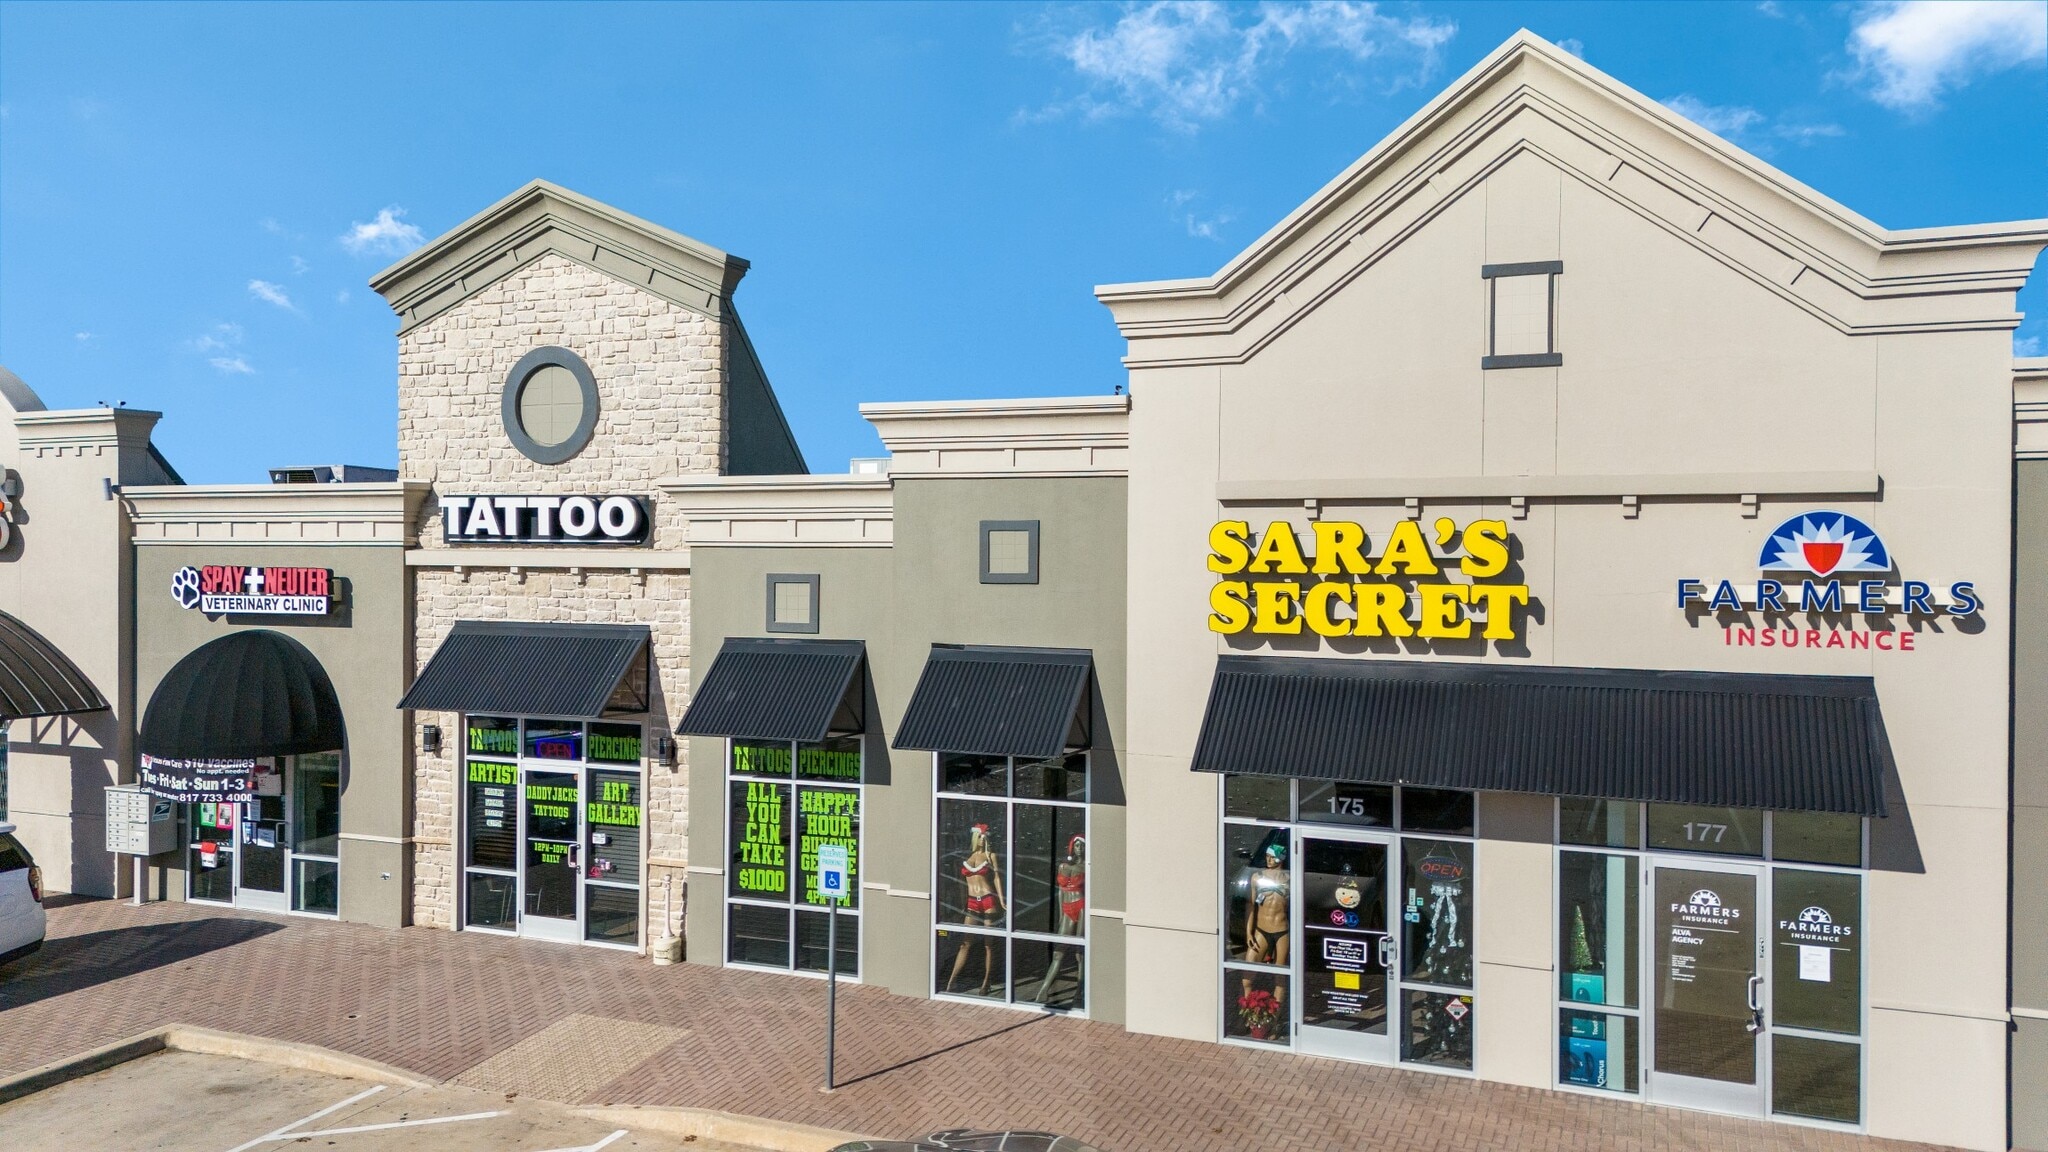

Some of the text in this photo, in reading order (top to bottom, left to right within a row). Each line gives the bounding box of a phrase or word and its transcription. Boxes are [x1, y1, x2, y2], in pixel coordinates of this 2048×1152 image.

[438, 496, 636, 537] TATTOO
[1207, 517, 1509, 578] SARA'S
[205, 597, 324, 612] VETERINARY CLINIC
[1676, 578, 1978, 615] FARMERS
[1208, 581, 1529, 640] SECRET
[1724, 627, 1915, 651] INSURANCE
[469, 727, 518, 753] TATTOOS
[538, 742, 572, 757] OPEN
[588, 735, 641, 760] PIERCINGS
[207, 757, 255, 768] Vaccines
[734, 746, 792, 774] TATTOOS
[800, 750, 861, 777] PIERCINGS
[159, 772, 170, 788] Fri
[171, 775, 188, 791] Sat
[193, 776, 219, 791] Sun
[220, 778, 245, 791] 1-3
[469, 763, 518, 785] ARTIST
[179, 793, 199, 802] 817
[202, 793, 223, 802] 733
[526, 785, 578, 802] DADDY JACKS
[603, 782, 630, 803] ART
[747, 782, 781, 804] ALL
[801, 790, 857, 815] HAPPY
[534, 804, 569, 818] TATTOOS
[588, 802, 641, 826] GALLERY
[746, 801, 780, 824] YOU
[1327, 797, 1364, 816] 175
[746, 822, 780, 844] CAN
[806, 814, 851, 837] HOUR
[1683, 821, 1727, 843] 177
[542, 853, 560, 864] DAILY
[740, 842, 785, 866] TAKE
[822, 858, 844, 867] PARKING
[739, 868, 785, 892] $1000
[1420, 863, 1463, 877] OPEN
[1671, 903, 1740, 918] FARMERS
[1682, 915, 1729, 925] INSURANCE
[1672, 928, 1692, 937] ALVA
[1780, 920, 1852, 936] FARMERS
[1791, 933, 1840, 943] INSURANCE
[1672, 936, 1704, 945] AGENCY
[1597, 1060, 1605, 1085] Chorus
